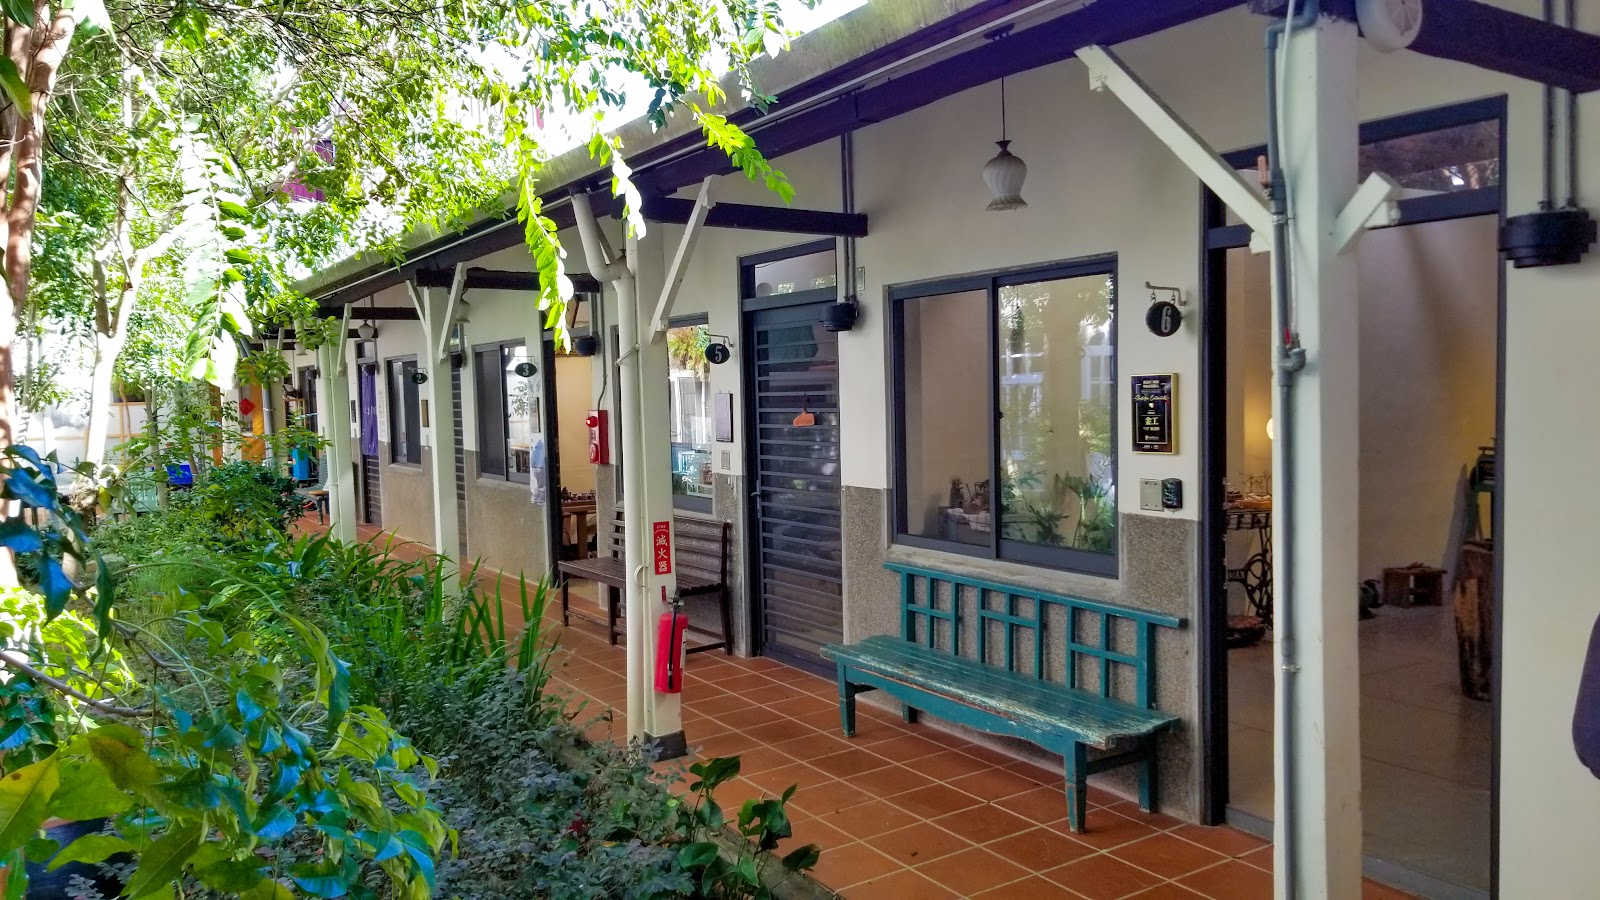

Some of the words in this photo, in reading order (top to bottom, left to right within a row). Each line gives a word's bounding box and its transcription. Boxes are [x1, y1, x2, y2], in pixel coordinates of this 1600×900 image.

[1161, 305, 1171, 333] 6
[715, 345, 723, 362] 5
[416, 374, 423, 383] 2
[522, 364, 530, 376] 3
[656, 534, 668, 573] 滅火器
